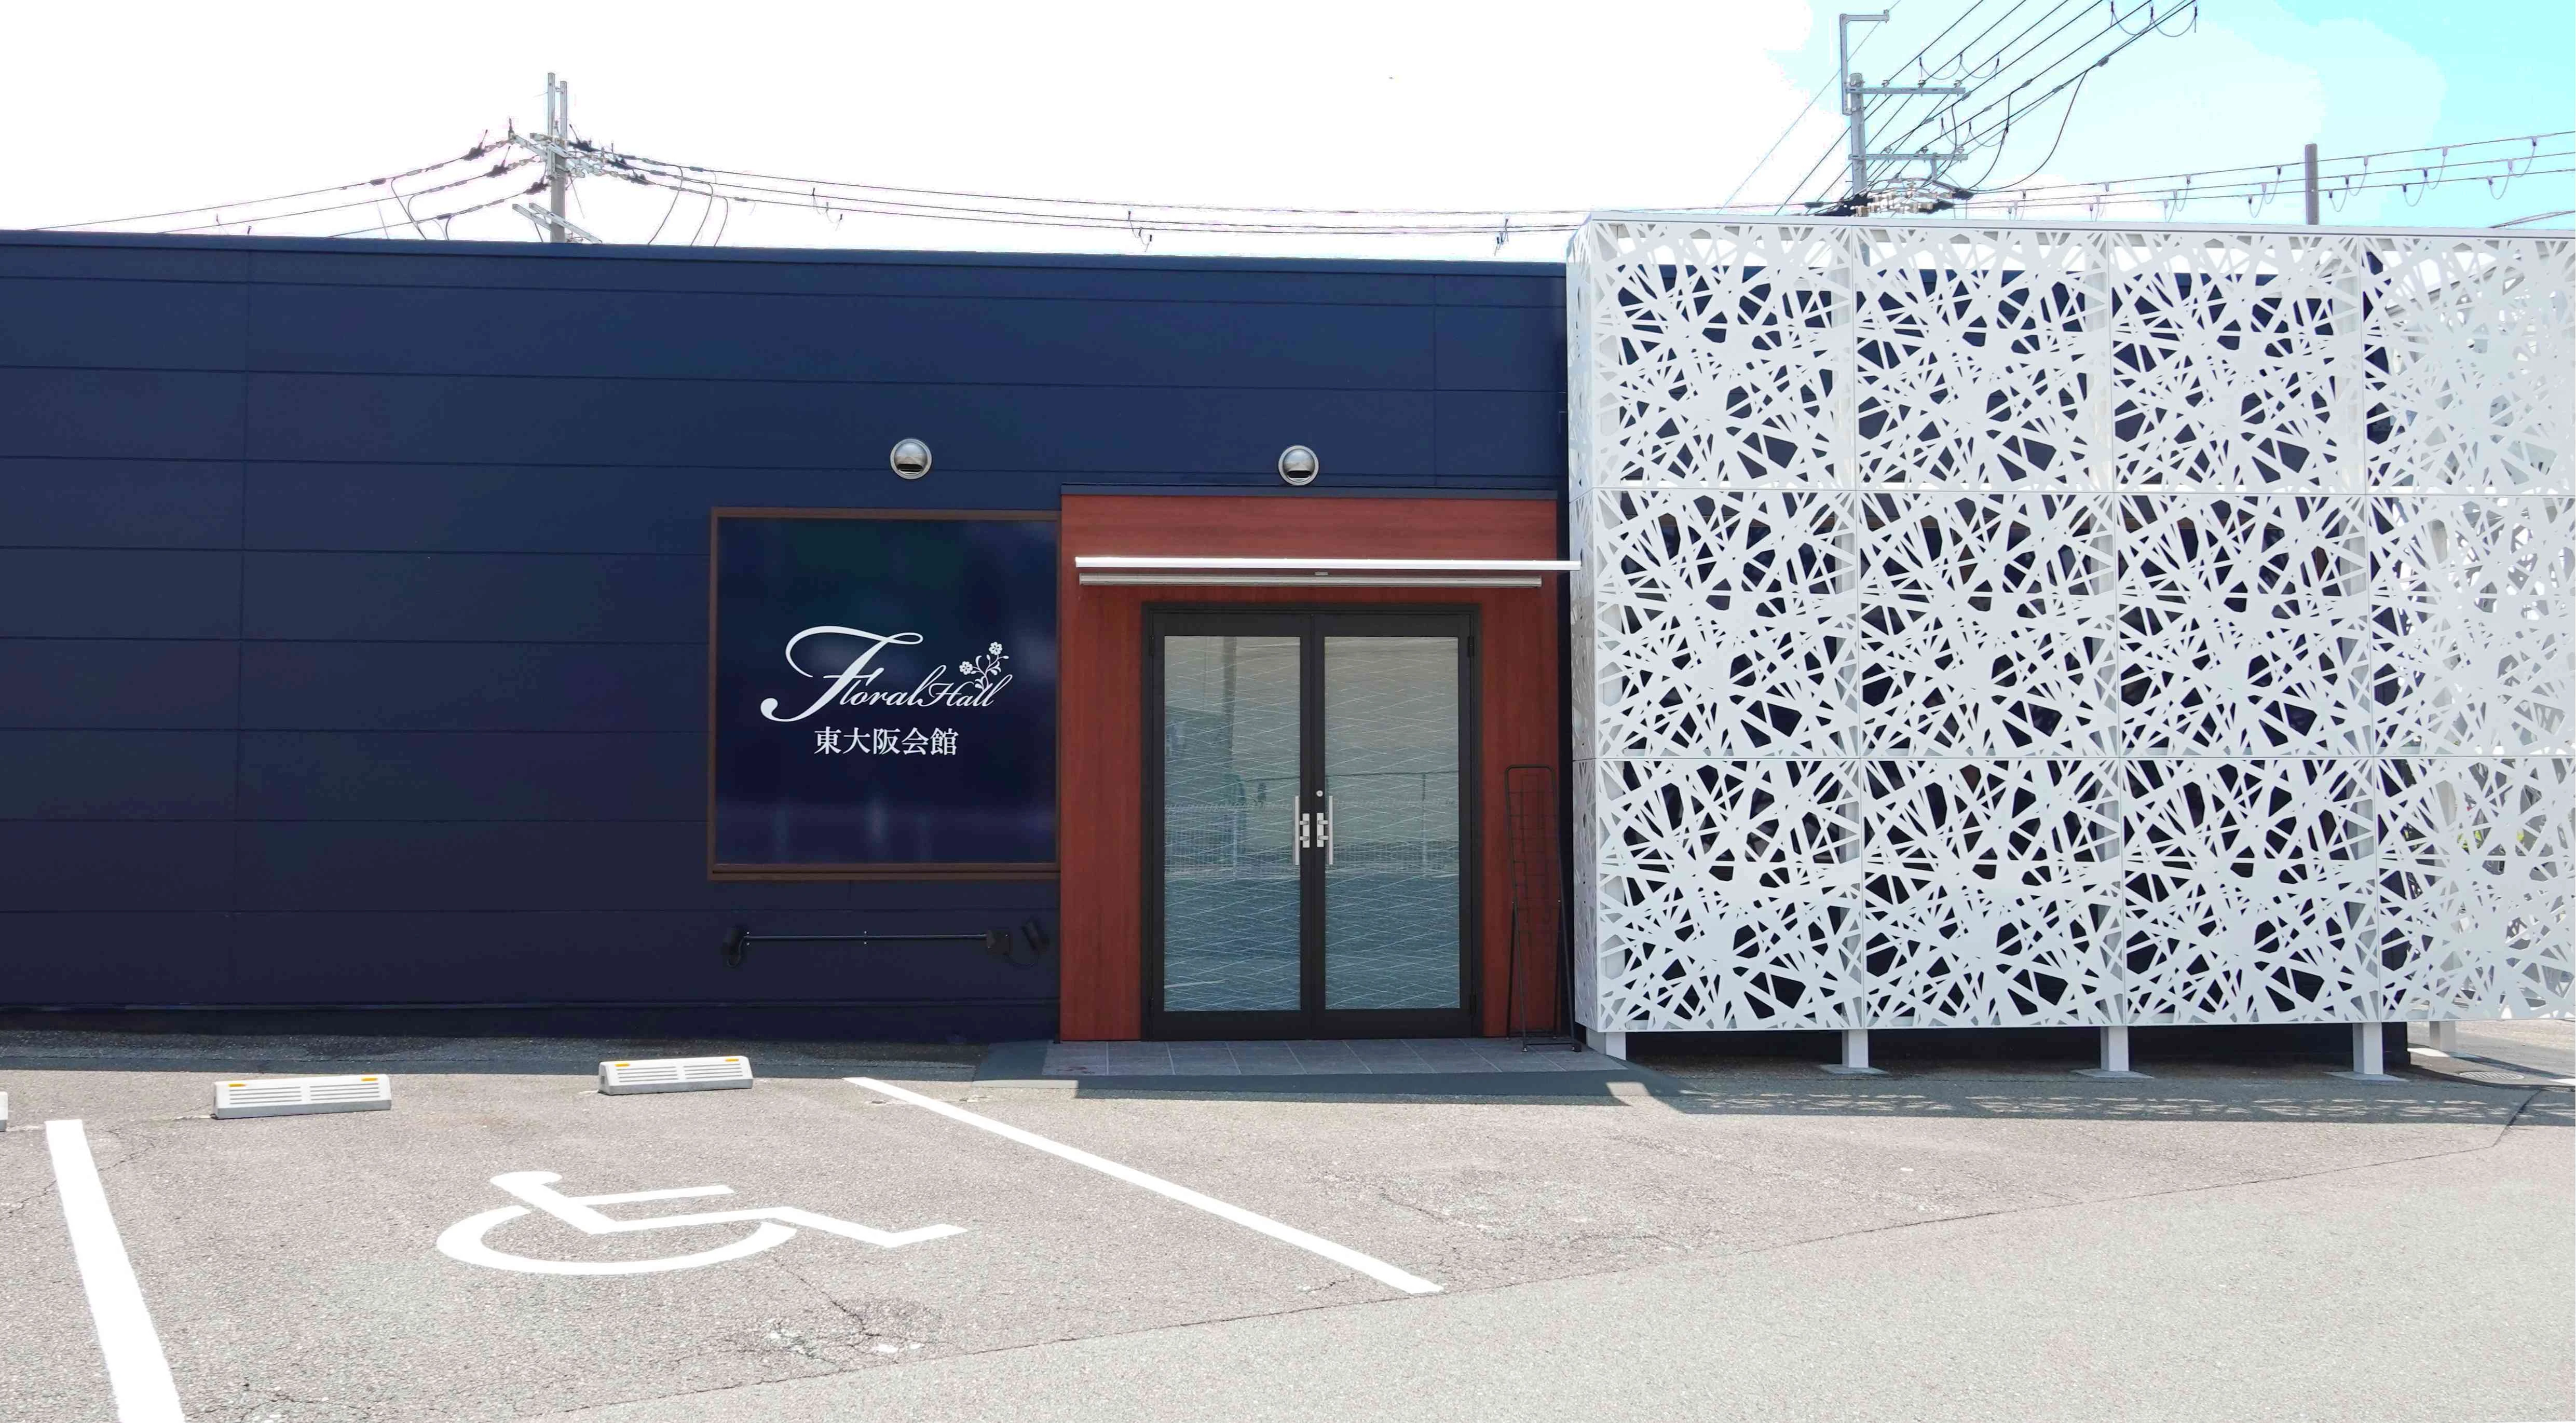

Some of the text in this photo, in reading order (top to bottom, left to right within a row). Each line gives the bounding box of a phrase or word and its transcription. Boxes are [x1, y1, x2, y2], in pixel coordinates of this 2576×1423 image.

[760, 625, 1013, 722] Floral Hall
[813, 726, 959, 755] 東大阪会館
